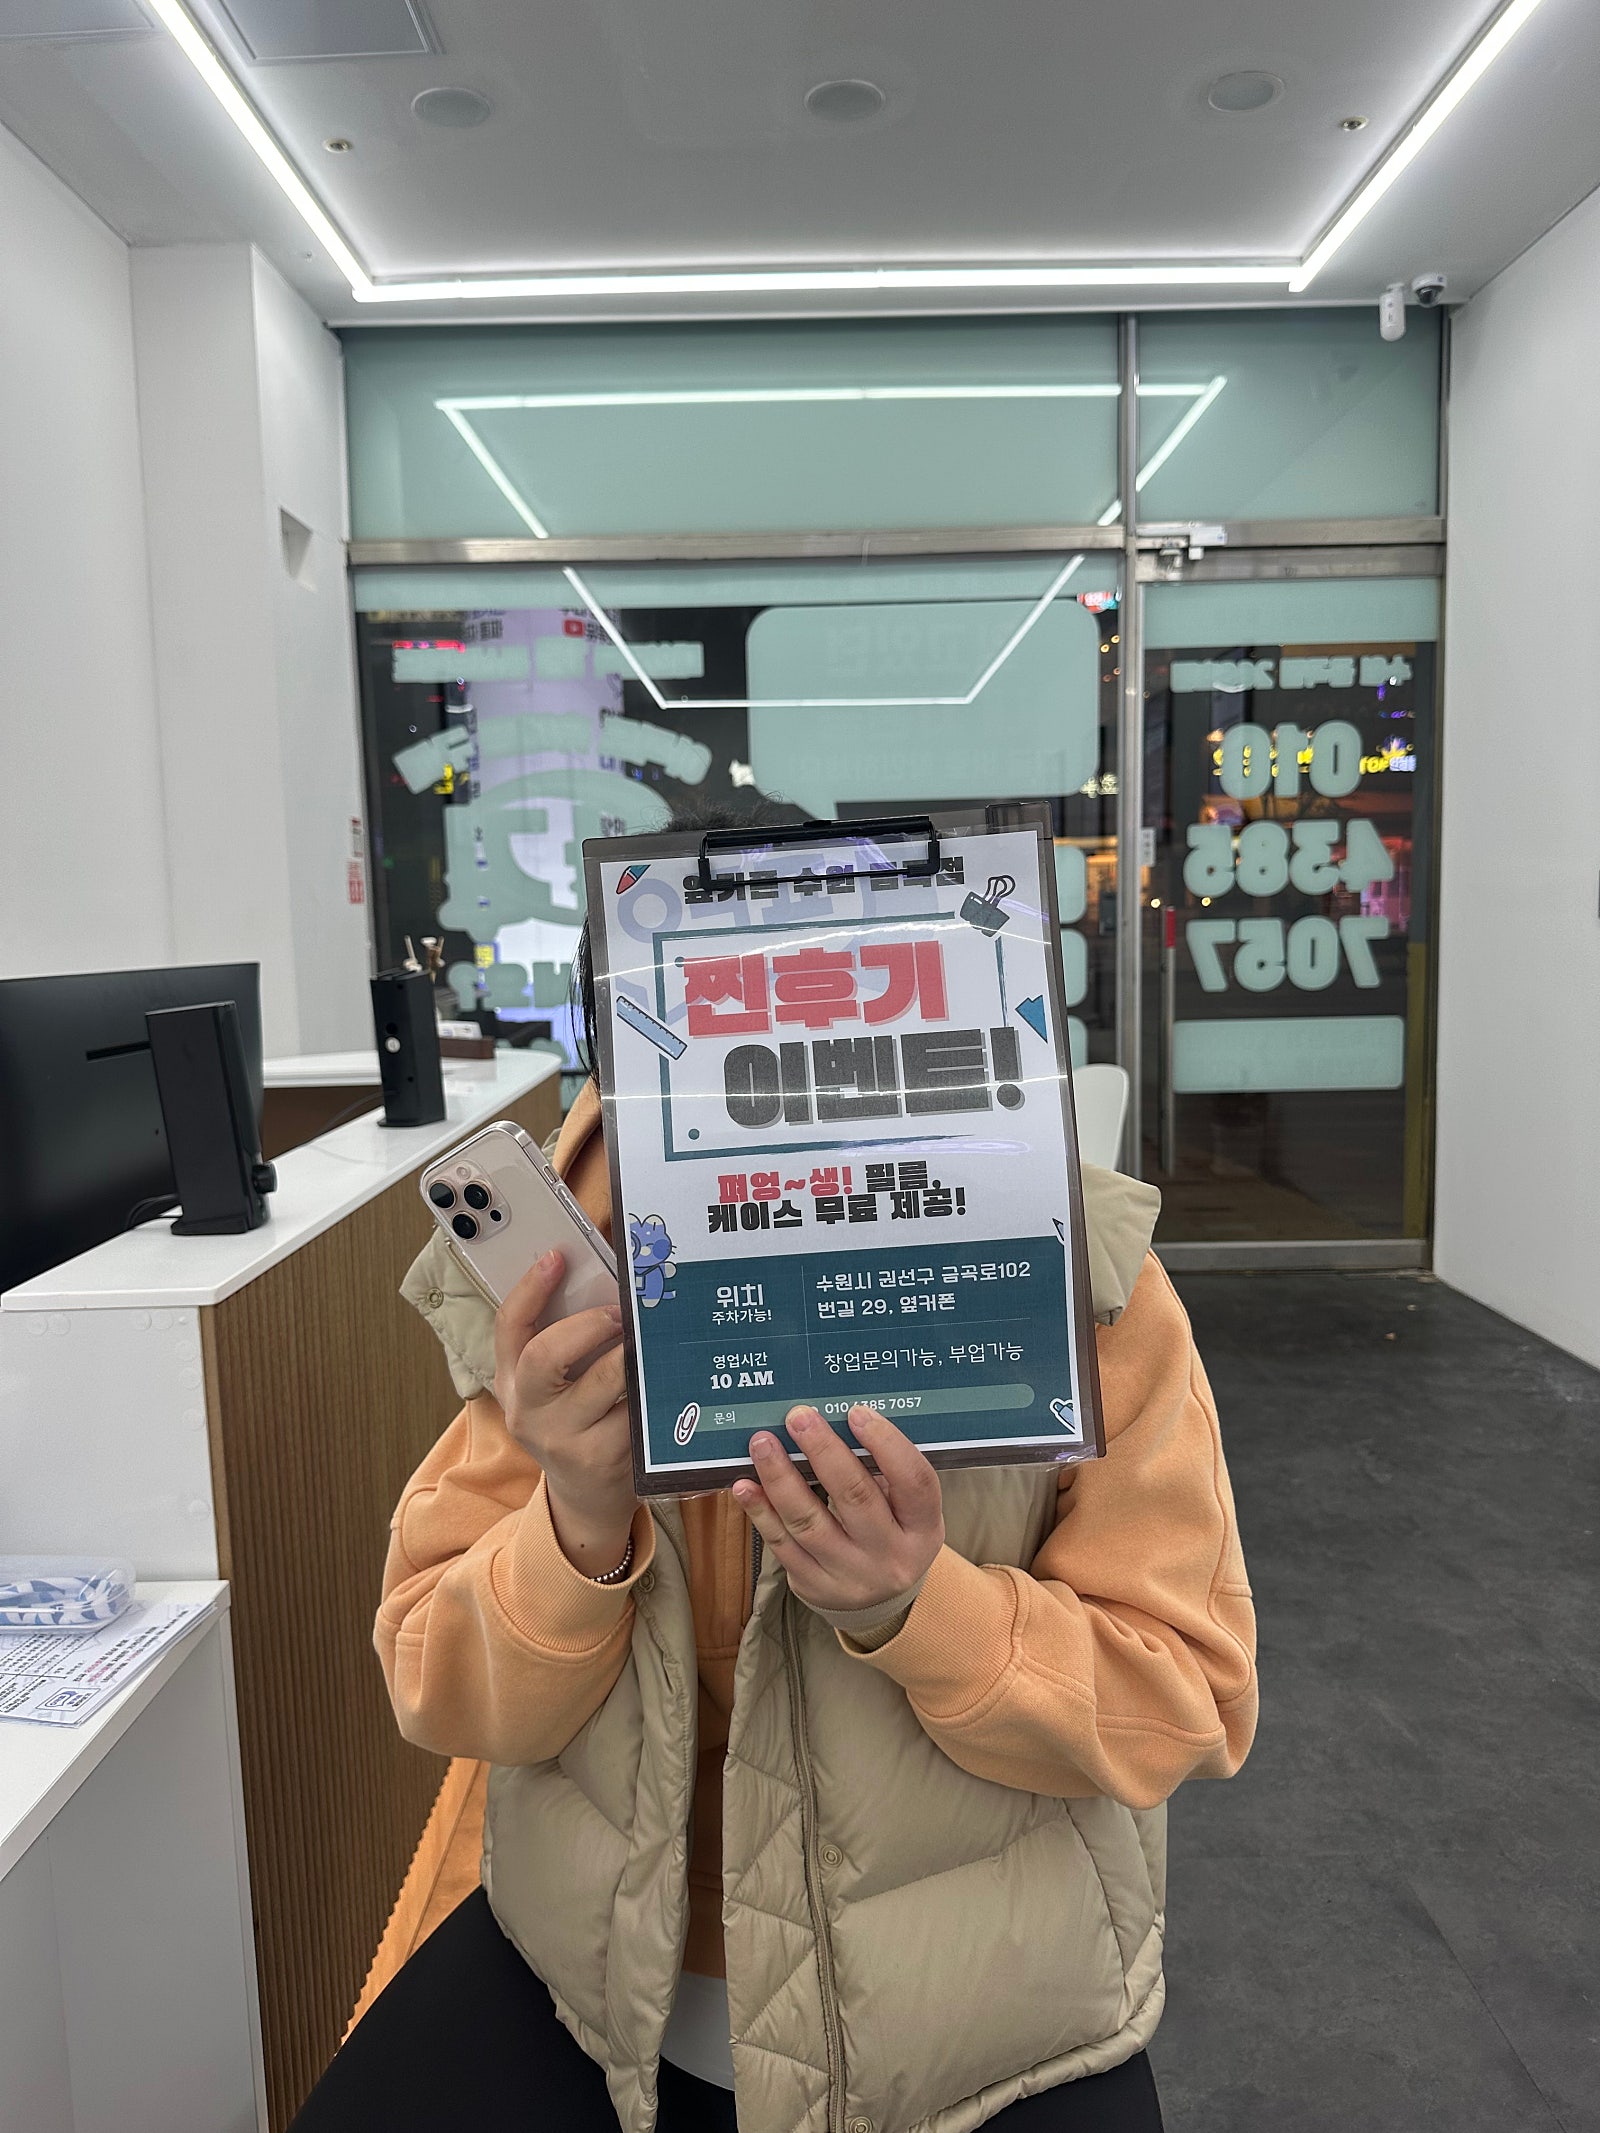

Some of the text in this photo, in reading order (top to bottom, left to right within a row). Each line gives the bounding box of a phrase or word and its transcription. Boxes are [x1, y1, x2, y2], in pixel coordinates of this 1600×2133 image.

[684, 941, 949, 1037] 찐후기
[723, 1026, 1026, 1129] 이벤트!
[707, 1185, 966, 1233] 케이스 무료 제공!
[816, 1261, 1031, 1292] 수원시 권선구 금곡로102
[716, 1283, 764, 1308] 위치
[817, 1292, 956, 1319] 번길 29, 옆커폰
[711, 1308, 772, 1326] 주차가능!
[713, 1351, 768, 1370] 영업시간
[824, 1342, 1024, 1374] 창업문의가능, 부업가능
[710, 1370, 775, 1390] 10 AM
[713, 1411, 736, 1425] 문의
[824, 1402, 849, 1414] 010
[888, 1396, 922, 1410] 7057
